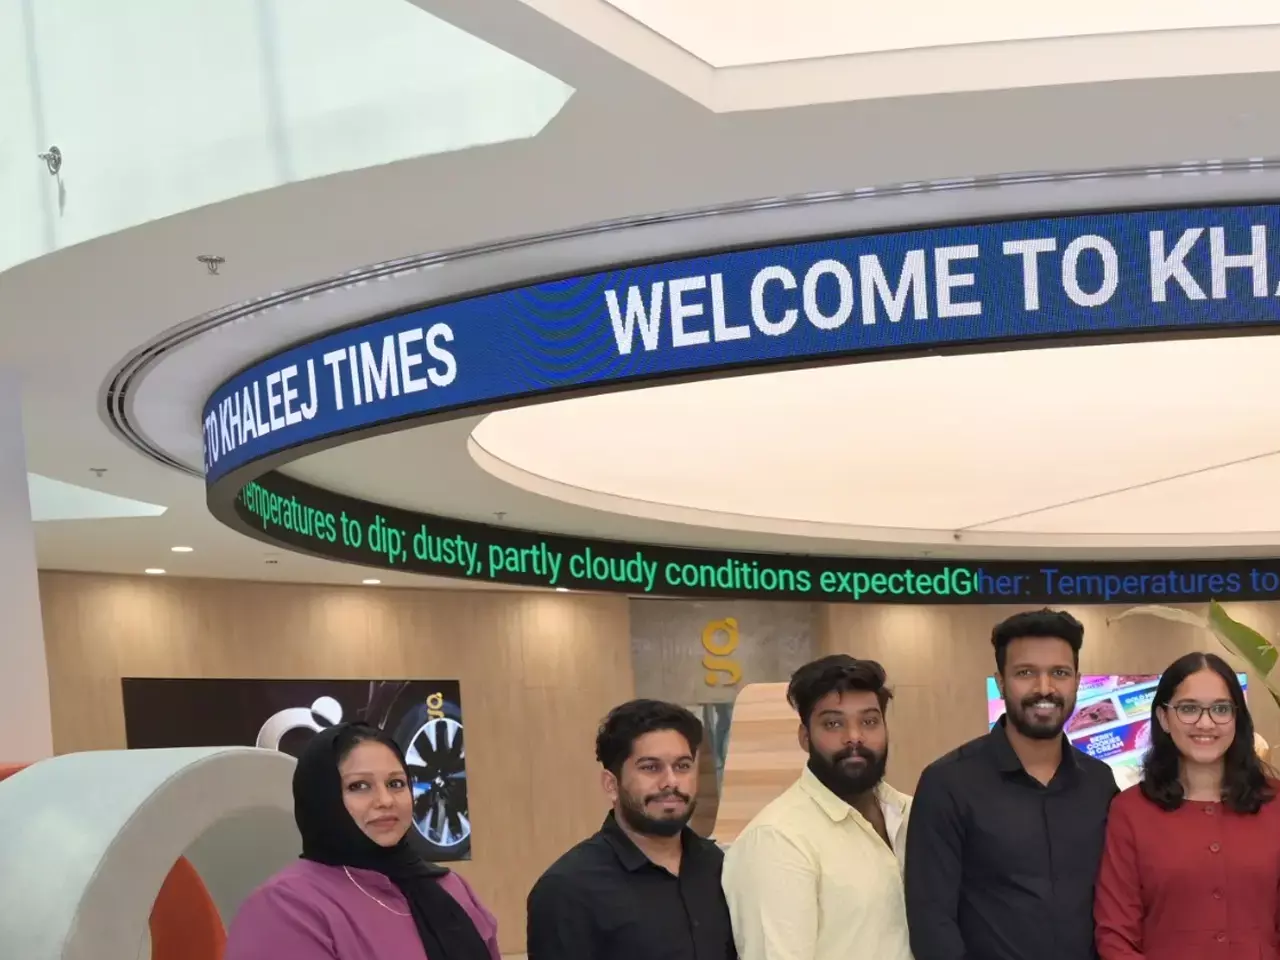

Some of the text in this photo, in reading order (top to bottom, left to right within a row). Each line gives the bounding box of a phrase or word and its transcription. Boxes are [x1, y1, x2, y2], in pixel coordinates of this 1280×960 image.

[604, 244, 982, 355] WELCOME
[1002, 234, 1119, 311] TO
[219, 359, 318, 456] KHALEEJ
[323, 322, 457, 410] TIMES
[341, 511, 362, 548] to
[368, 515, 408, 563] dip;
[413, 524, 482, 576] dusty,
[489, 542, 561, 585] partly
[569, 548, 658, 592] cloudy
[665, 558, 811, 592] conditions
[1040, 568, 1241, 600] Temperatures
[1252, 567, 1280, 592] to
